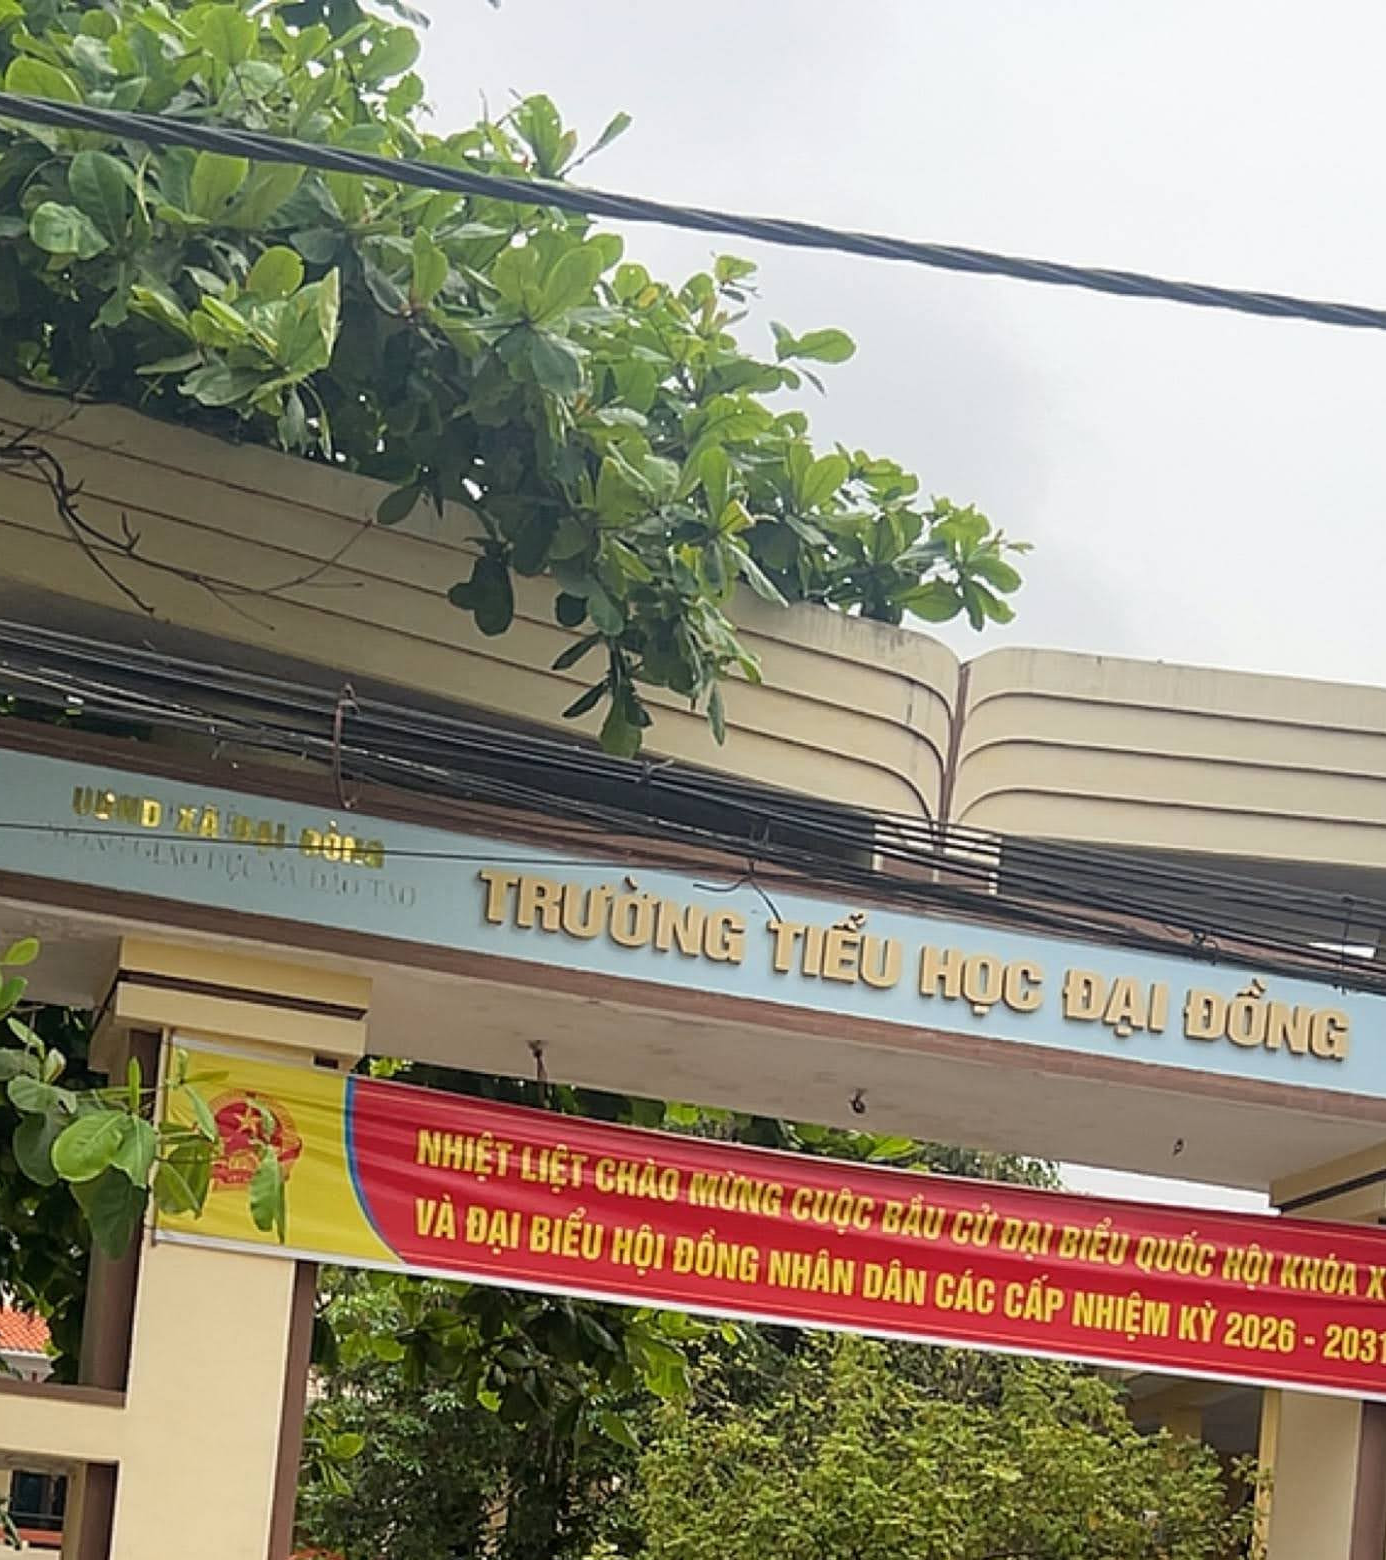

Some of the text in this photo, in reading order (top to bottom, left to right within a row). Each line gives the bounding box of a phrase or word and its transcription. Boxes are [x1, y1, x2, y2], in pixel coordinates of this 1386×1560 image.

[479, 868, 1351, 1062] TRƯỜNG TIỂU HỌC ĐẠI ĐỒNG
[415, 1129, 512, 1182] NHIỆT
[521, 1143, 588, 1194] LIỆT
[595, 1157, 680, 1202] CHÀO
[688, 1169, 783, 1220] MỪNG
[791, 1187, 875, 1235] CUỘC
[882, 1193, 945, 1240] BẦU
[952, 1203, 998, 1248] CỬ
[999, 1216, 1051, 1261] ĐẠI
[1059, 1216, 1130, 1266] BIỂU
[1134, 1230, 1216, 1278] QUỐC
[1222, 1243, 1274, 1291] HỘI
[1280, 1253, 1358, 1297] KHÓA
[415, 1193, 456, 1240] VÀ
[466, 1206, 521, 1255] ĐẠI
[529, 1206, 603, 1261] BIỂU
[611, 1224, 665, 1276] HỘI
[673, 1228, 760, 1283] ĐỒNG
[768, 1246, 855, 1297] NHÂN
[863, 1259, 927, 1306] DÂN
[935, 1269, 997, 1315] CÁC
[1003, 1275, 1065, 1323] CẤP
[1072, 1291, 1170, 1342] NHIỆM
[1178, 1300, 1218, 1343] KỲ
[1223, 1311, 1296, 1354] 2026
